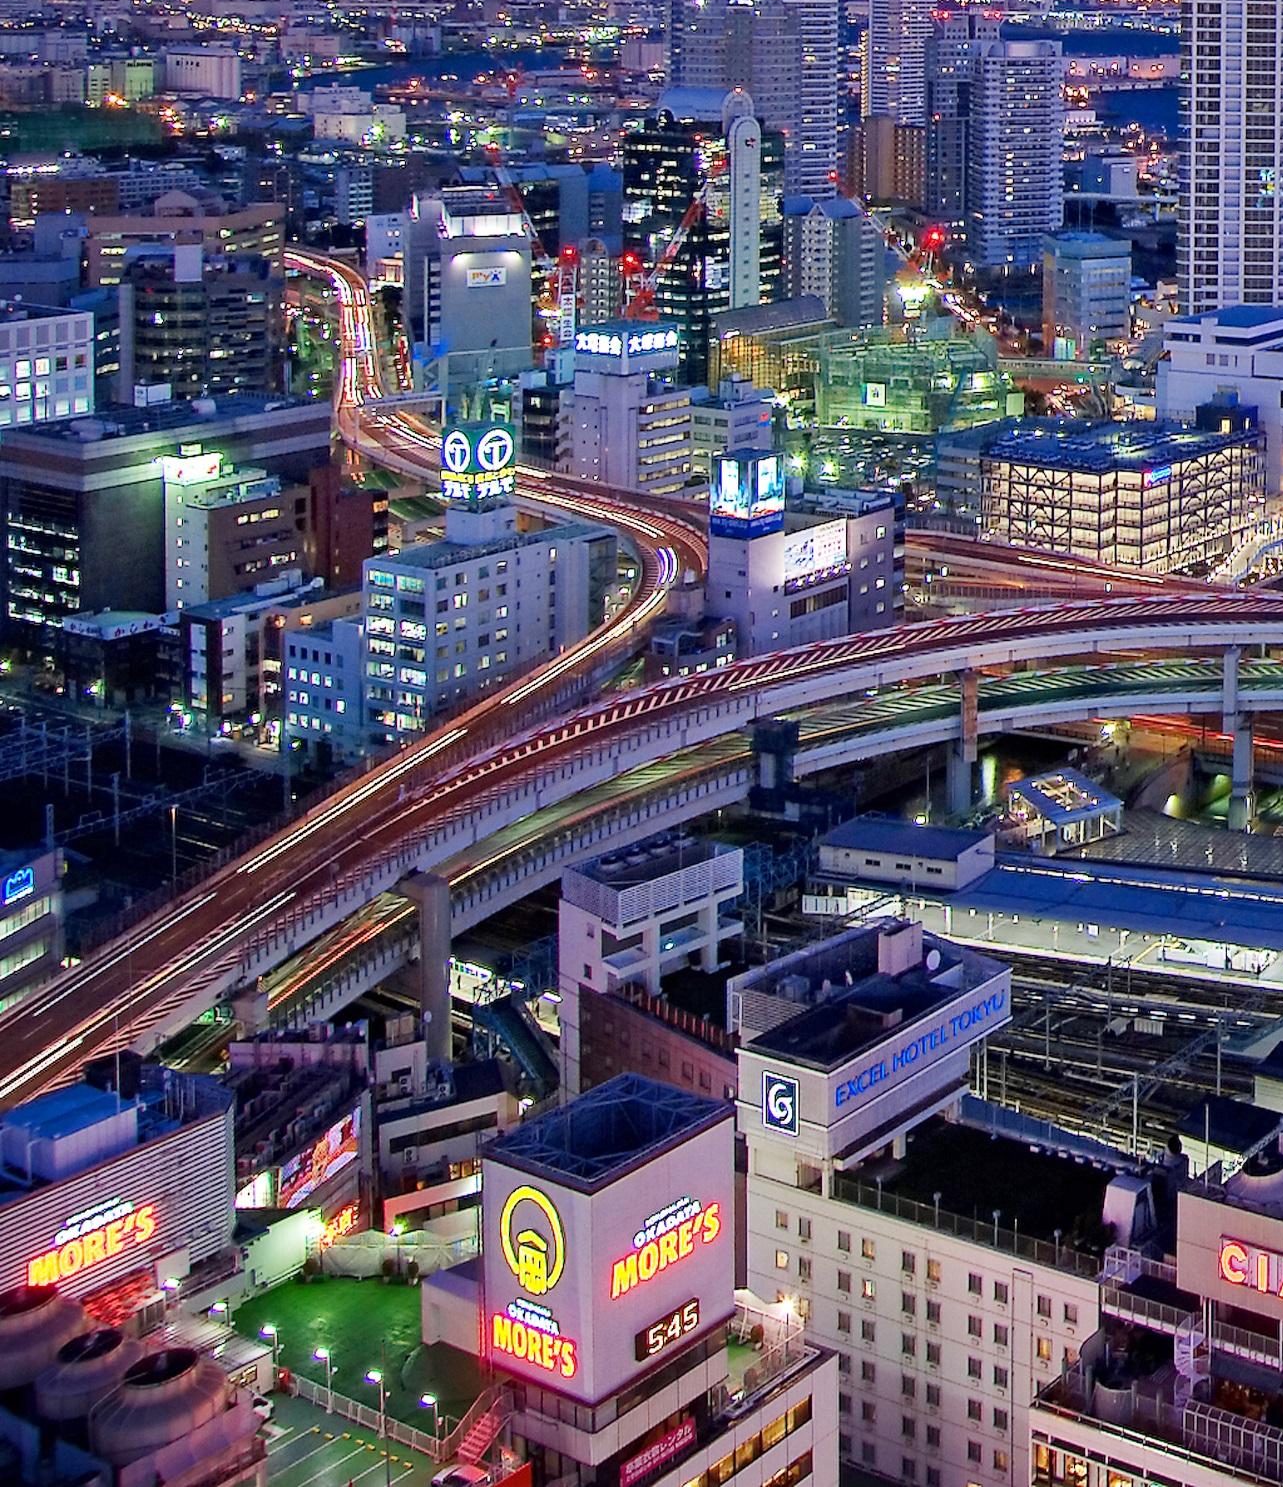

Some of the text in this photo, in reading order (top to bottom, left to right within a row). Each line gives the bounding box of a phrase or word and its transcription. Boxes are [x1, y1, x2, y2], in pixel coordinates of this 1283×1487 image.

[835, 990, 1005, 1107] EXCEL HOTEL TOKYU
[27, 1204, 158, 1287] MORE'S
[611, 1203, 721, 1300] MORE'S
[493, 1314, 576, 1378] MORE'S
